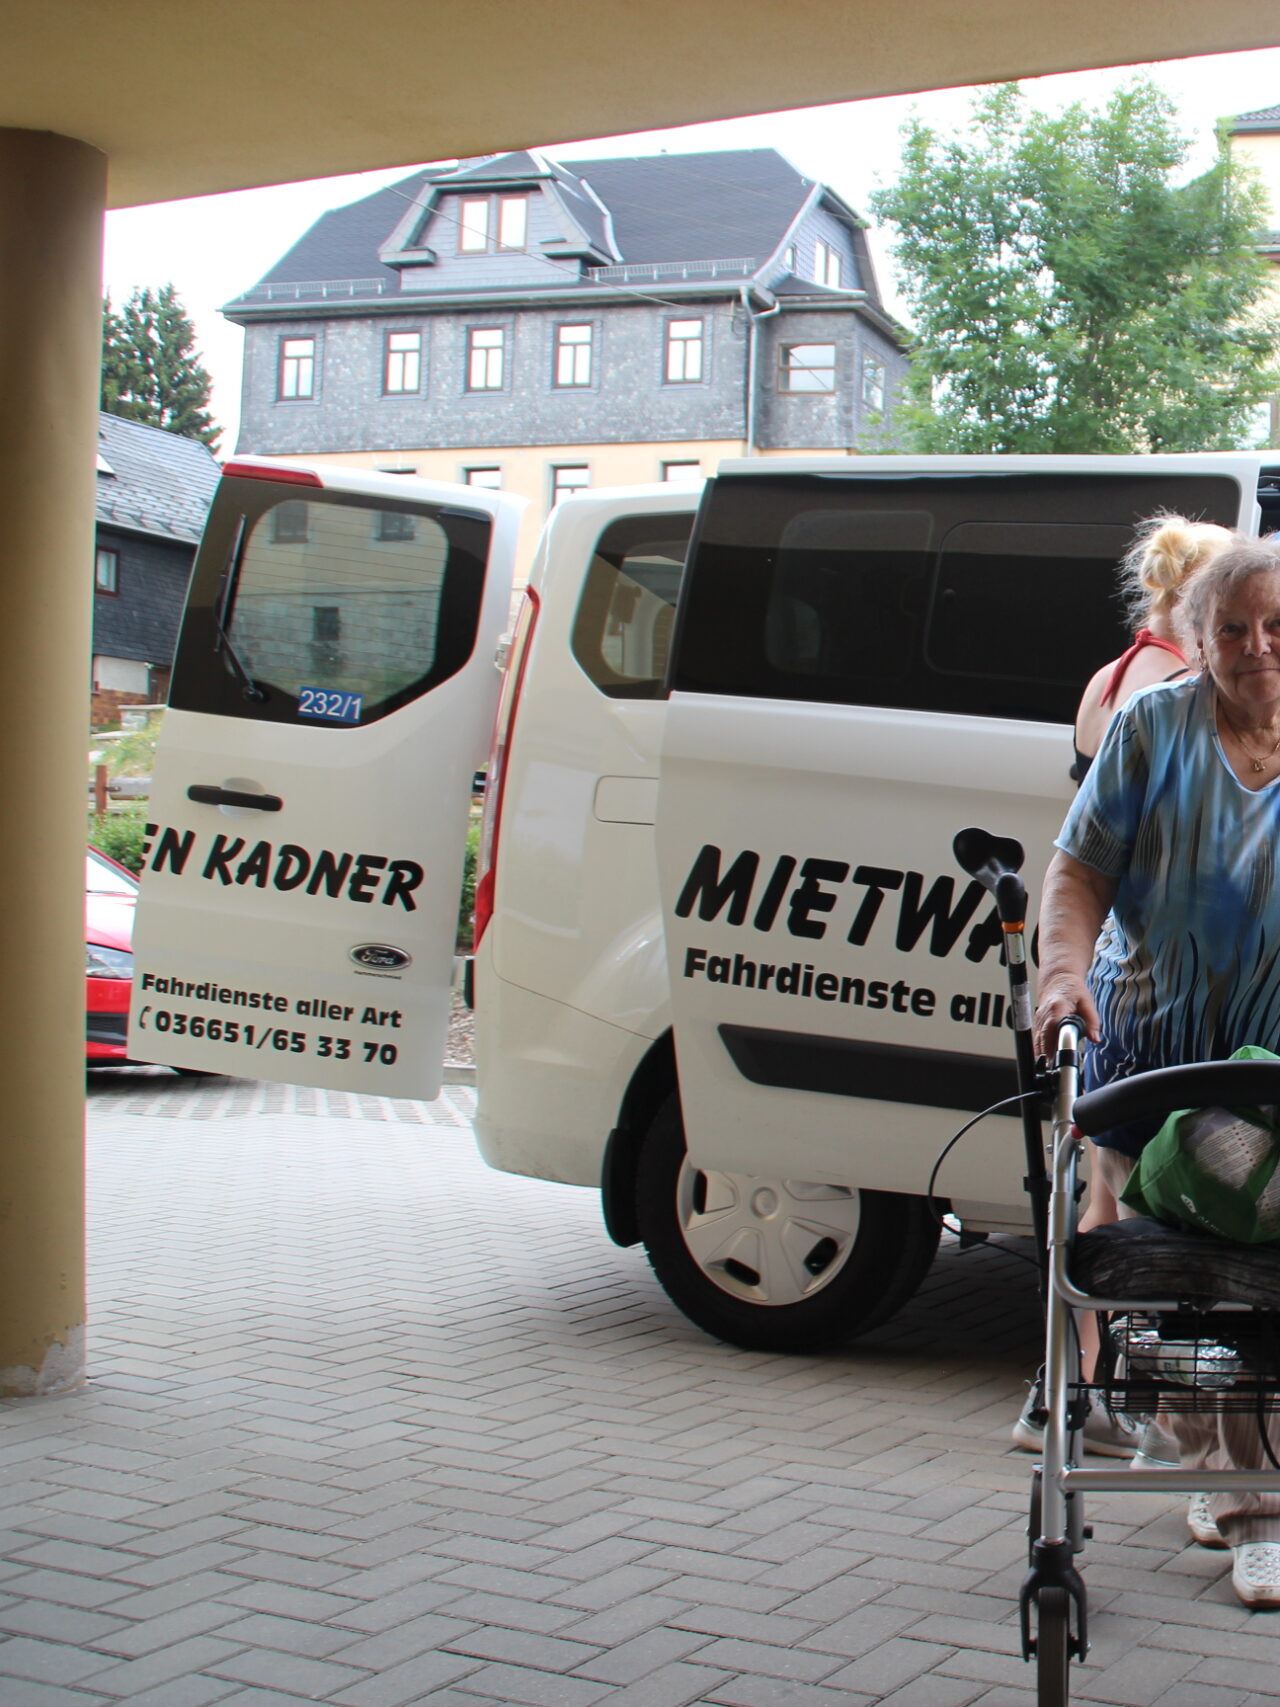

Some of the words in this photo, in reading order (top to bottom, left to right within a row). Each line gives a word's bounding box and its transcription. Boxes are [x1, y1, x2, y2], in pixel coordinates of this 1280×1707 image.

[298, 690, 362, 719] 232/1
[202, 834, 424, 912] KADNER
[674, 844, 1040, 970] MIETWA
[141, 973, 288, 1013] Fahrdienste
[296, 998, 354, 1022] aller
[361, 1007, 402, 1028] Art
[683, 947, 937, 1017] Fahrdienste
[949, 991, 1014, 1031] all
[155, 1010, 306, 1053] 036651/65
[317, 1035, 351, 1060] 33
[363, 1041, 398, 1066] 70
